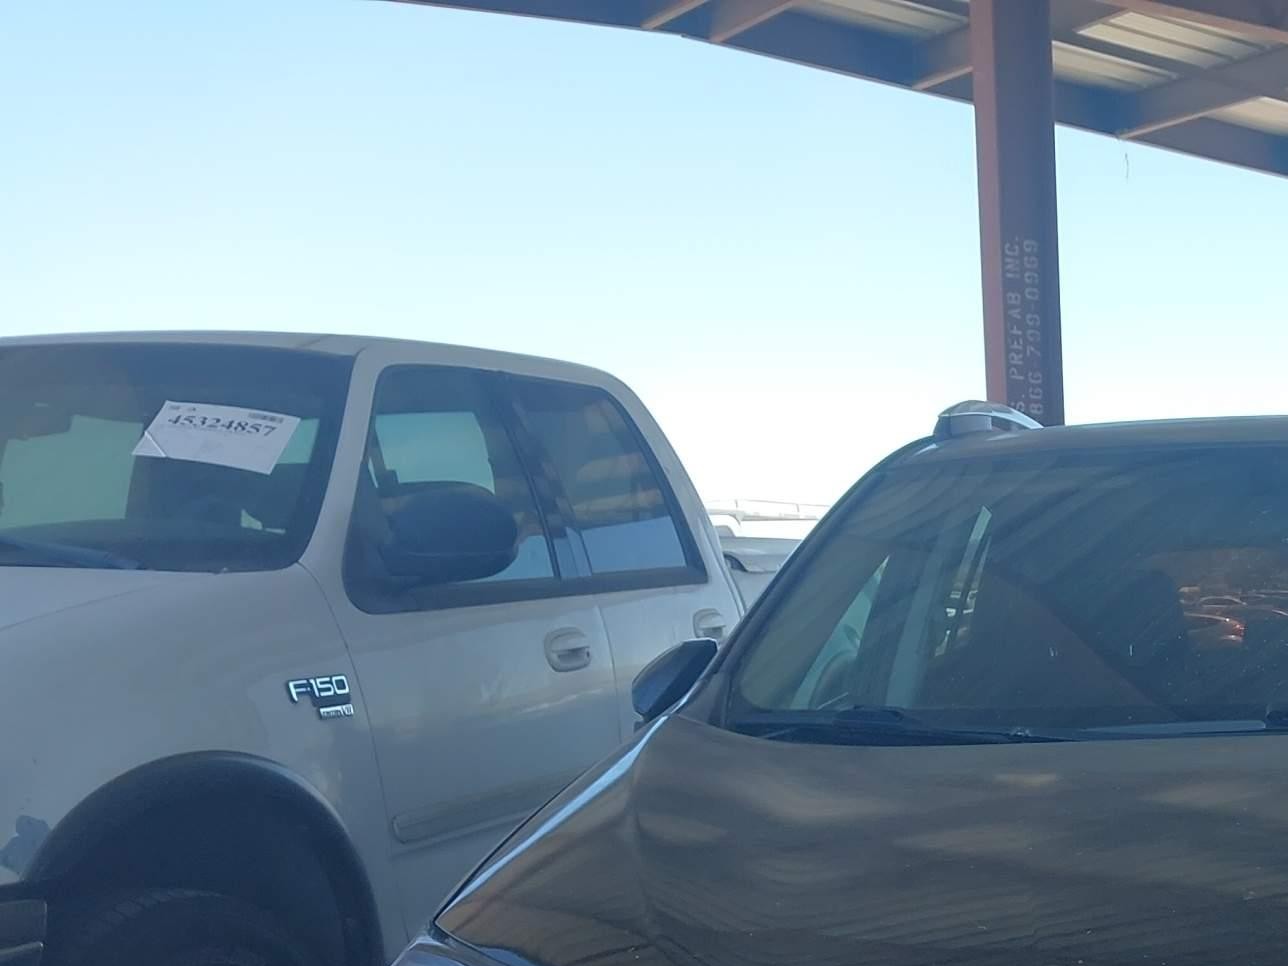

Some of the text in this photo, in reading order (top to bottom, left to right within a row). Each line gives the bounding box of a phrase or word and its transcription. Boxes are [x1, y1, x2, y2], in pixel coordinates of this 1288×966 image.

[1004, 236, 1021, 279] INC.
[1007, 292, 1025, 380] PREFAB
[168, 414, 277, 437] 45324857
